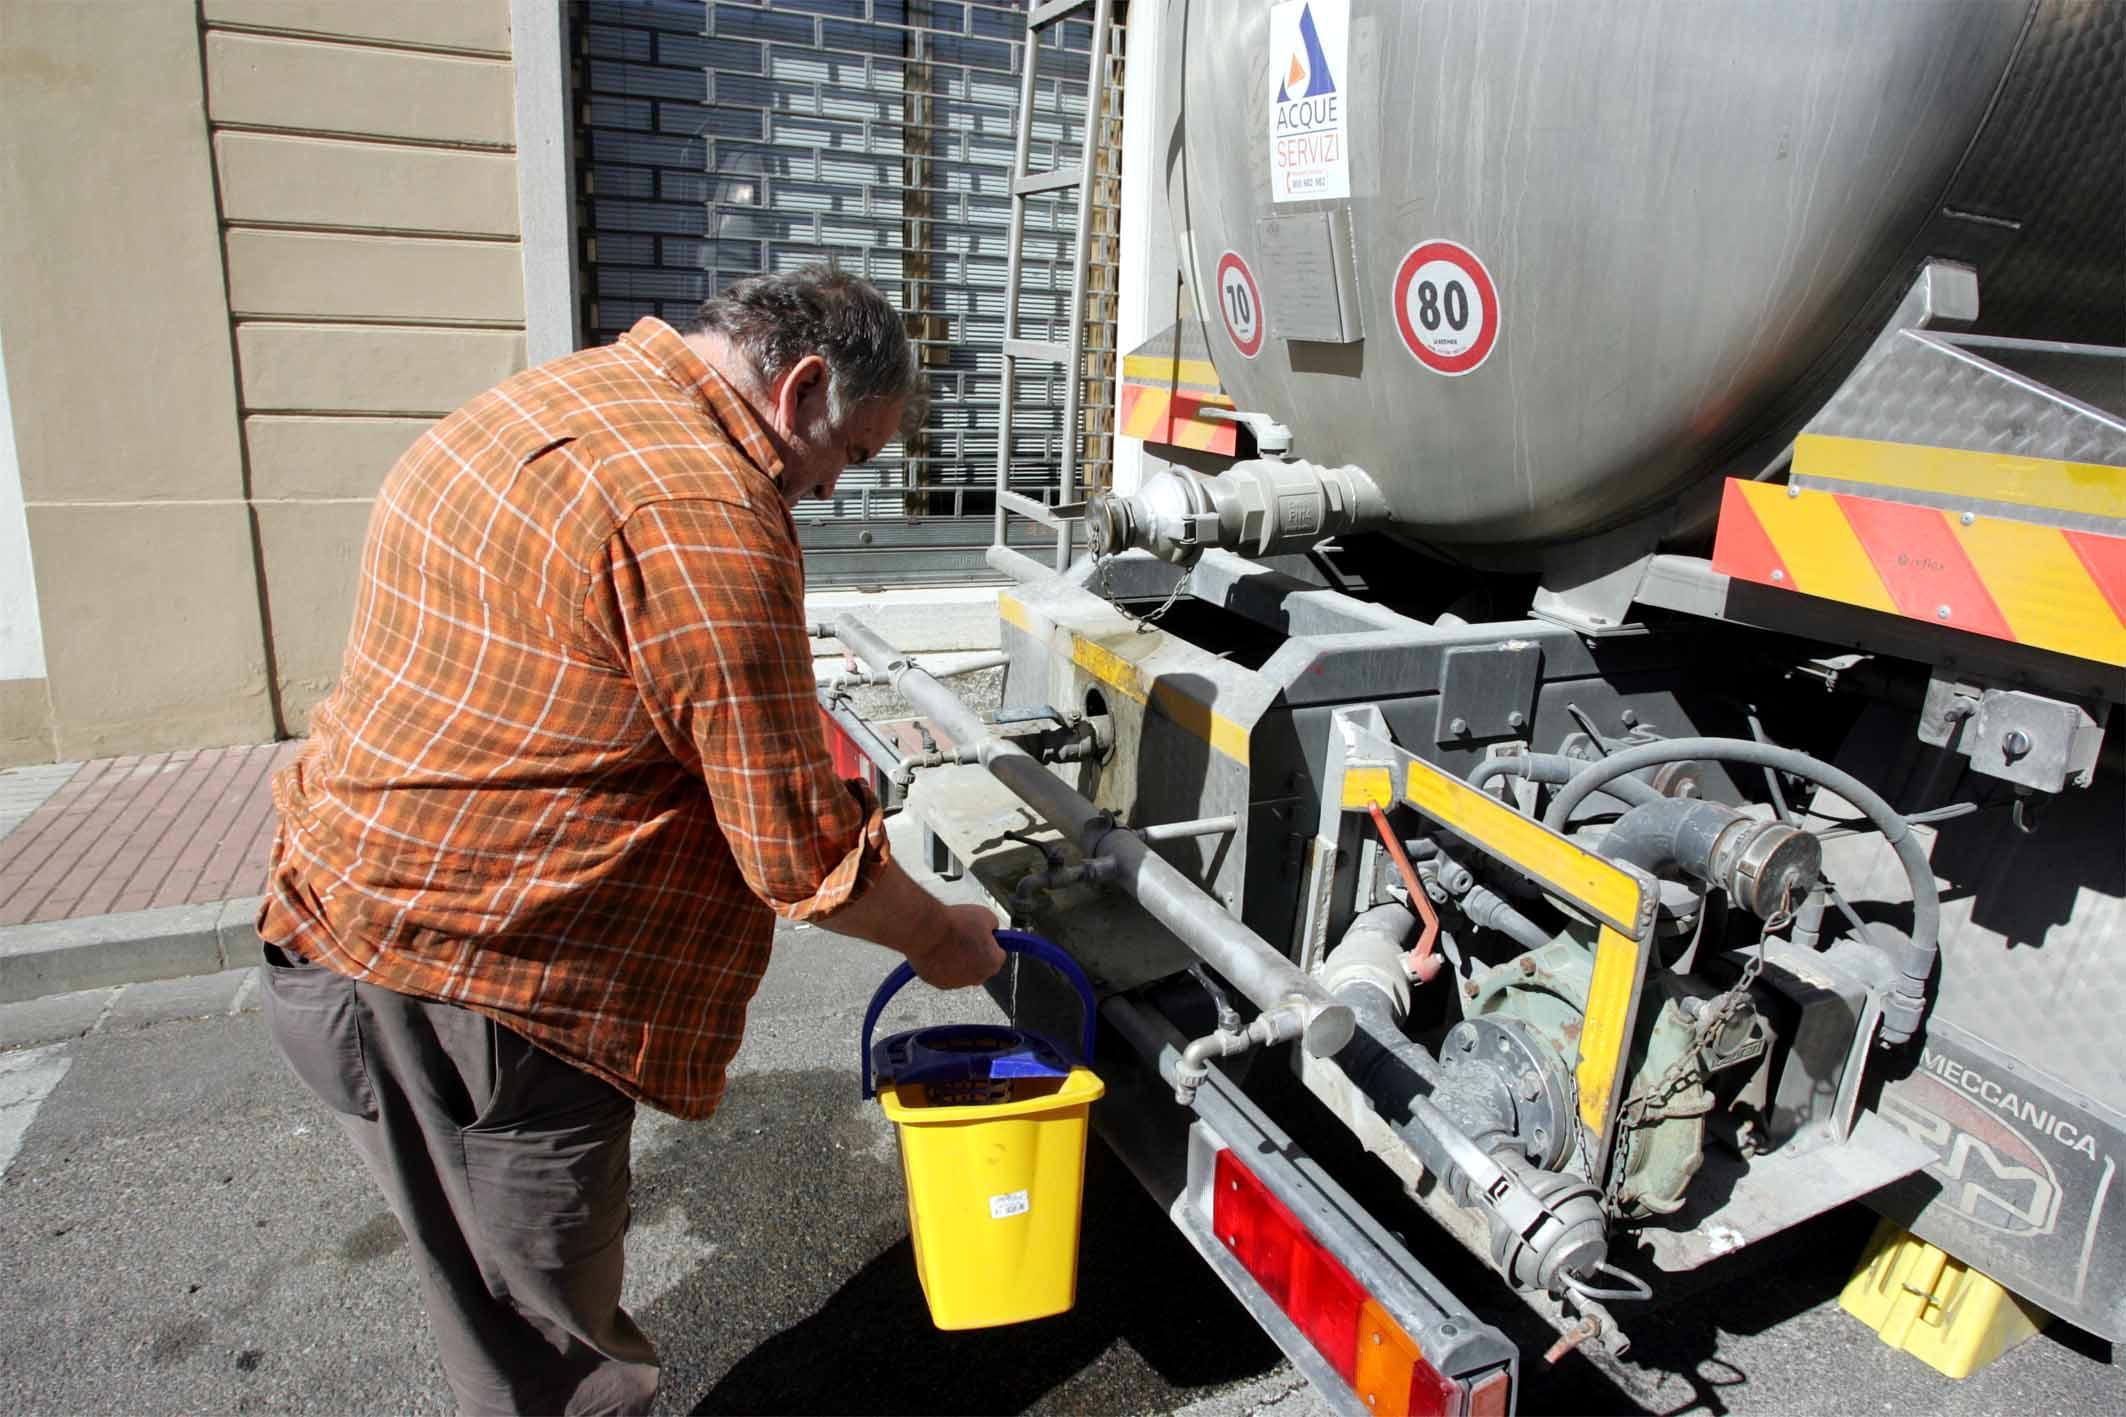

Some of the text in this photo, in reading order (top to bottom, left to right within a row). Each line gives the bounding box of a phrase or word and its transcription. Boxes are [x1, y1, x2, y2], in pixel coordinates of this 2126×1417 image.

[1277, 97, 1338, 130] ACQUE
[1277, 133, 1339, 168] SERVIZI
[1418, 280, 1469, 331] 80
[1920, 1047, 2096, 1161] MECCANICA
